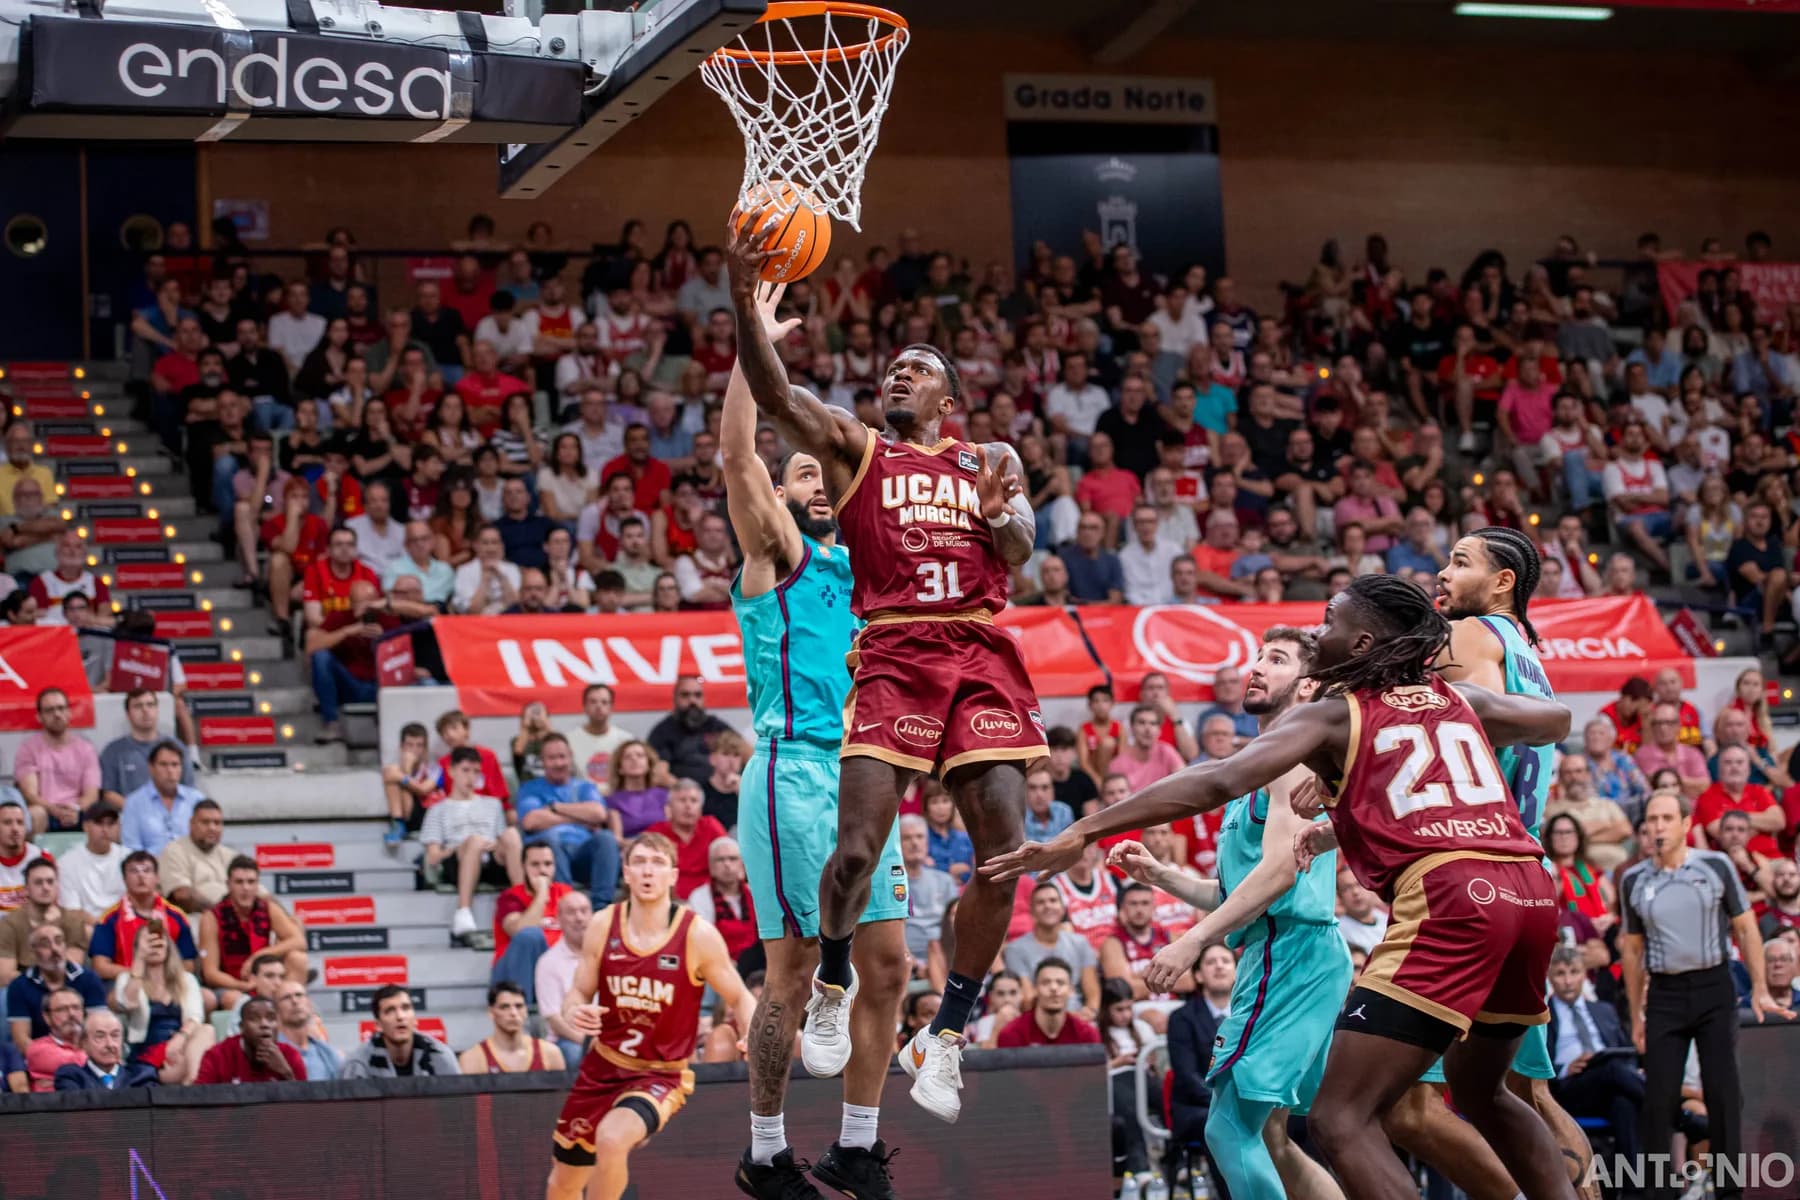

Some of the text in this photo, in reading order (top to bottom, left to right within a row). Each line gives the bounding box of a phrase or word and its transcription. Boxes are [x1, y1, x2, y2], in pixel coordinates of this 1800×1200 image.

[118, 38, 451, 120] endesa
[1014, 84, 1205, 112] Grada Norte
[881, 474, 983, 519] UCAM
[899, 504, 972, 531] MURCIA
[916, 561, 964, 603] 31
[899, 721, 943, 740] Juver
[977, 718, 1019, 731] Juver
[1373, 720, 1507, 820] 20
[606, 975, 675, 1007] UCAM
[618, 1028, 645, 1058] 2
